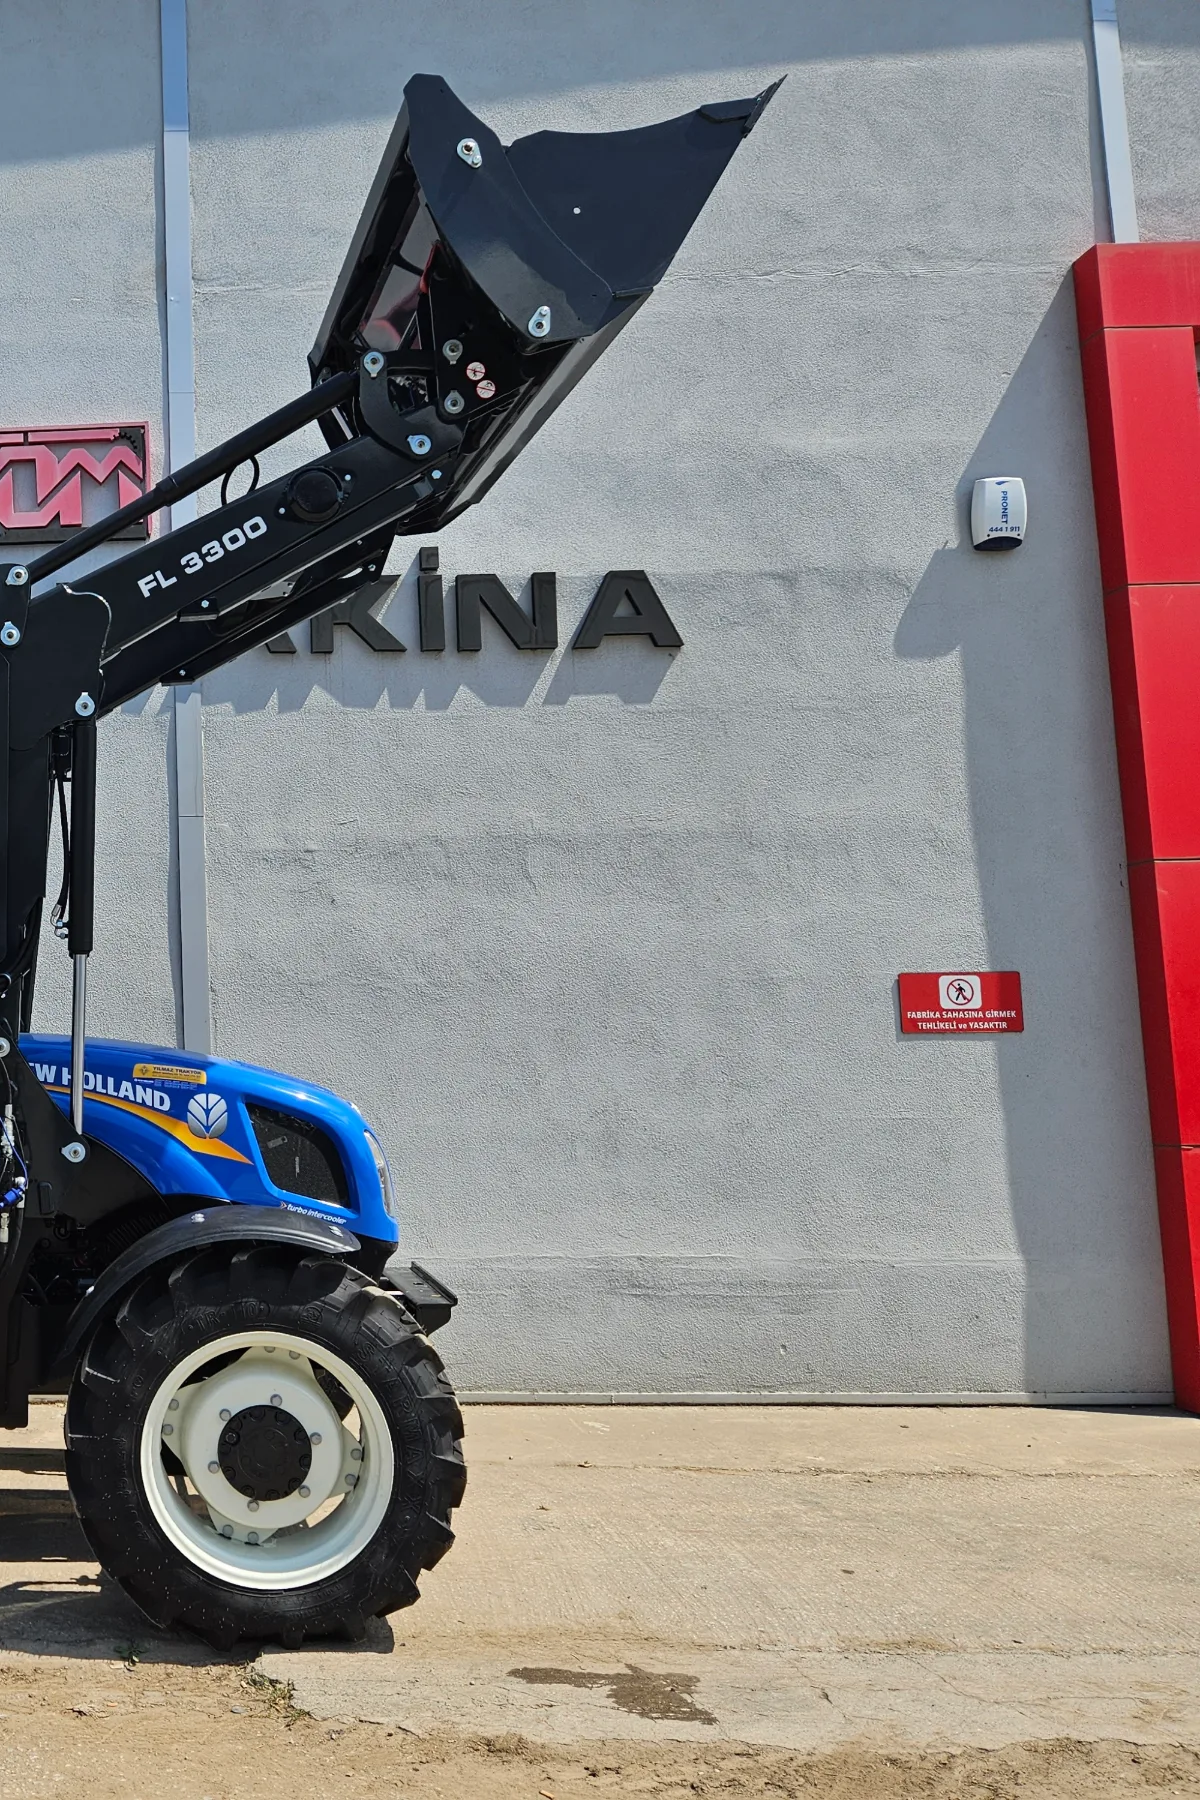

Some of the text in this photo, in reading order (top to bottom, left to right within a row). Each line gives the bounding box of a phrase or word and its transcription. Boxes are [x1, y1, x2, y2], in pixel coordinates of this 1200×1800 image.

[137, 516, 267, 598] FL 3300
[265, 546, 684, 653] KİNA
[907, 1009, 1016, 1019] FABRİKA SAHASINA GİRMEK
[918, 1021, 956, 1029] TEHLİKELİ
[969, 1021, 1007, 1029] YASAKTIR
[287, 1204, 346, 1224] turbo intercooler
